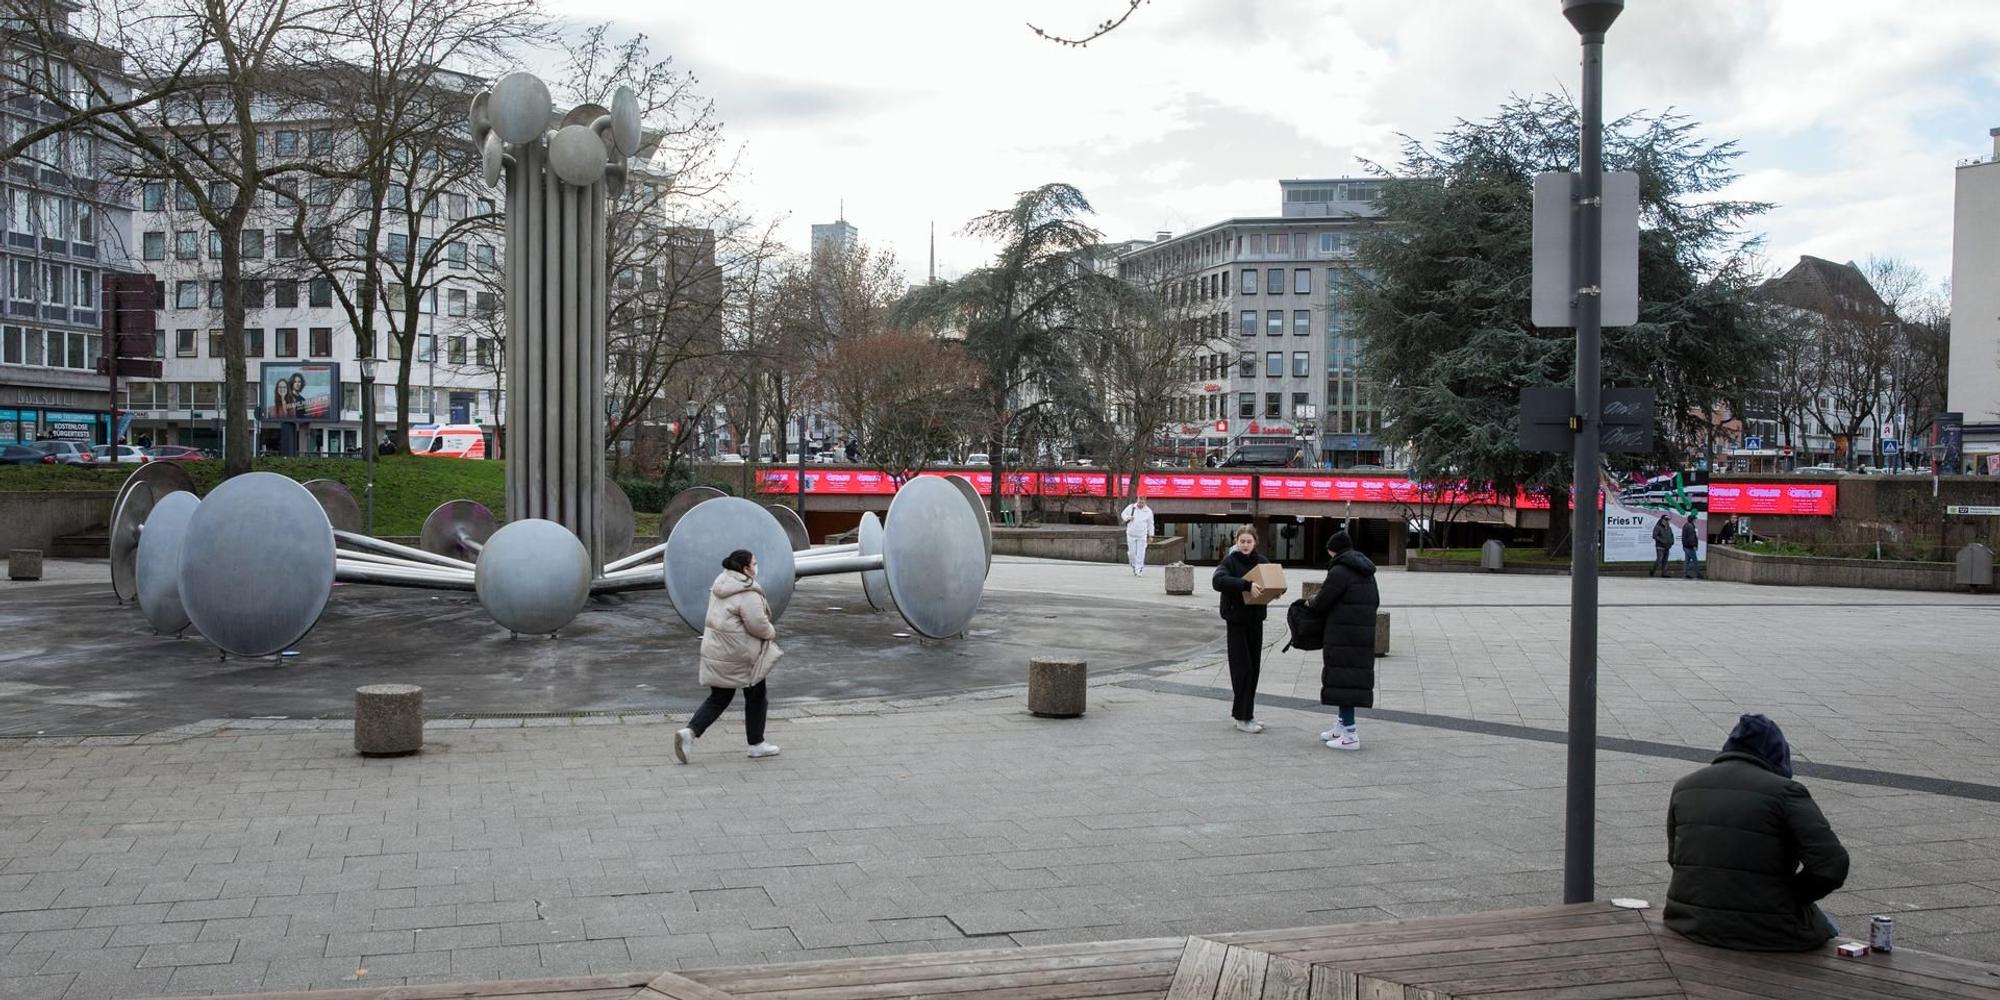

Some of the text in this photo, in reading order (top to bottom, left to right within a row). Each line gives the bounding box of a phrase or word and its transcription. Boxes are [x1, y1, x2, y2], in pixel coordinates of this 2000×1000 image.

[54, 423, 88, 431] KOSTENLOSE
[1607, 516, 1644, 525] Fries TV
